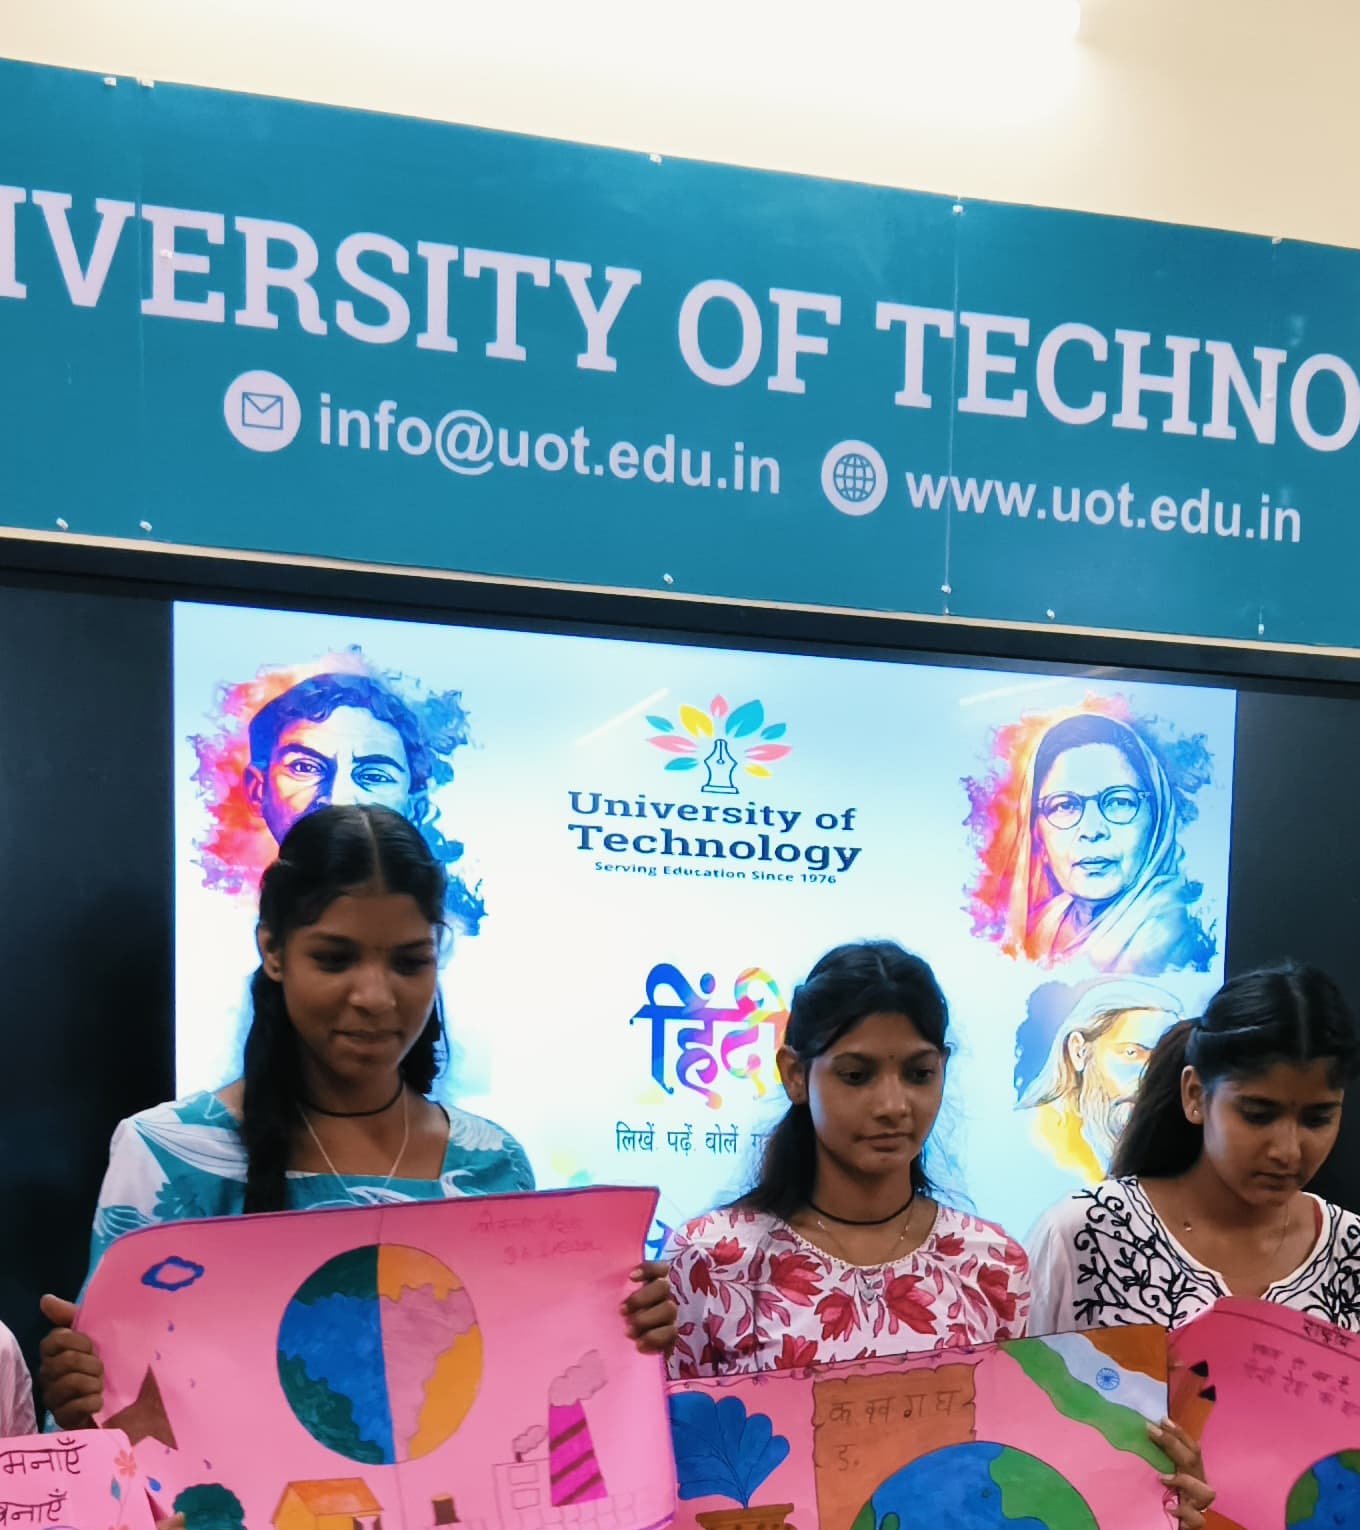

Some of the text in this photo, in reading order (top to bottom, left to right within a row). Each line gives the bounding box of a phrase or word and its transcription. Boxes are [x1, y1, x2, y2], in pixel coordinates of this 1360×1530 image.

[677, 279, 842, 394] OF
[319, 393, 781, 496] info@uot.edu.in
[905, 467, 1302, 544] www.uot.edu.in
[568, 791, 857, 833] University of
[568, 823, 862, 873] Technology
[595, 861, 837, 884] Serving Education Since 1976
[830, 1401, 855, 1424] क
[903, 1394, 928, 1418] ग
